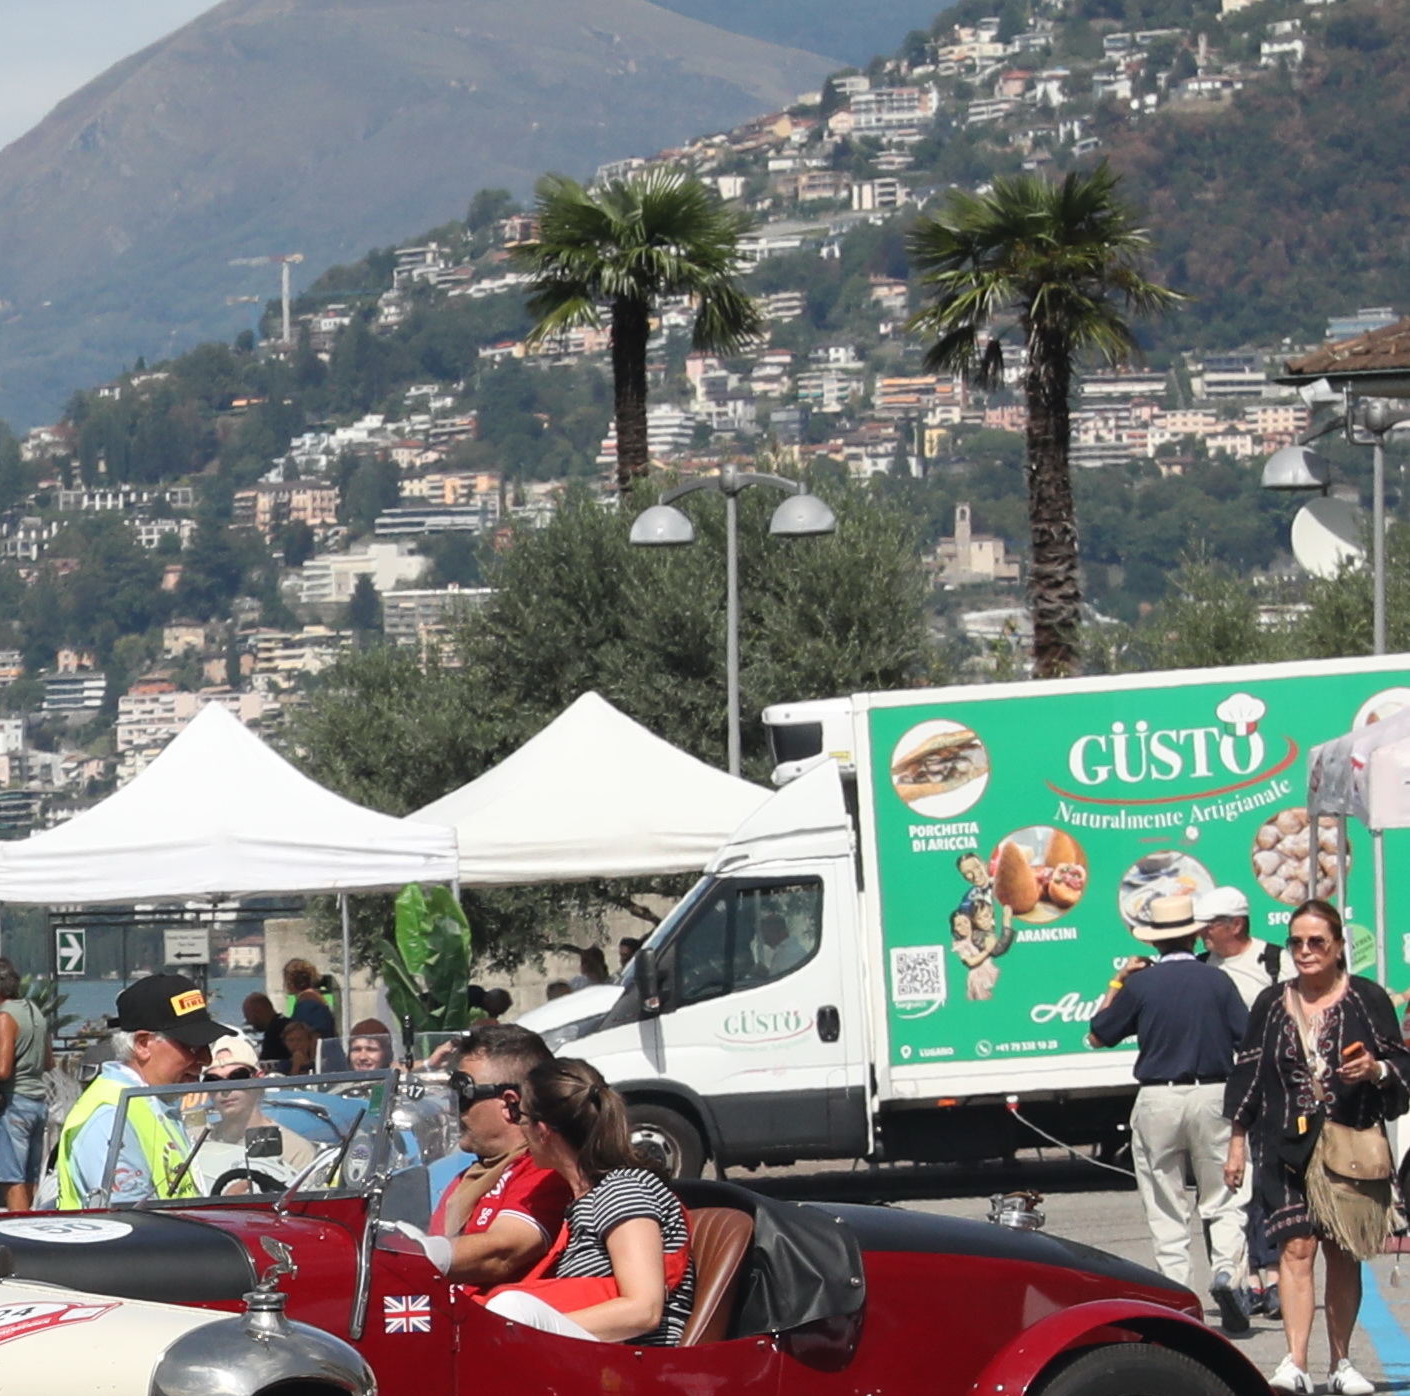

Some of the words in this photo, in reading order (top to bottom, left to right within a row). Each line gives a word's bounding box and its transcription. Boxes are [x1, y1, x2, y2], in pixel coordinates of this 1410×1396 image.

[1054, 801, 1184, 830] Naturalmente
[1189, 778, 1292, 823] Artigianale
[908, 822, 979, 838] PORCHETTA
[912, 839, 926, 852] DI
[927, 836, 978, 851] ARICCIA
[1016, 927, 1077, 942] ARANCINI
[408, 1086, 423, 1098] 17
